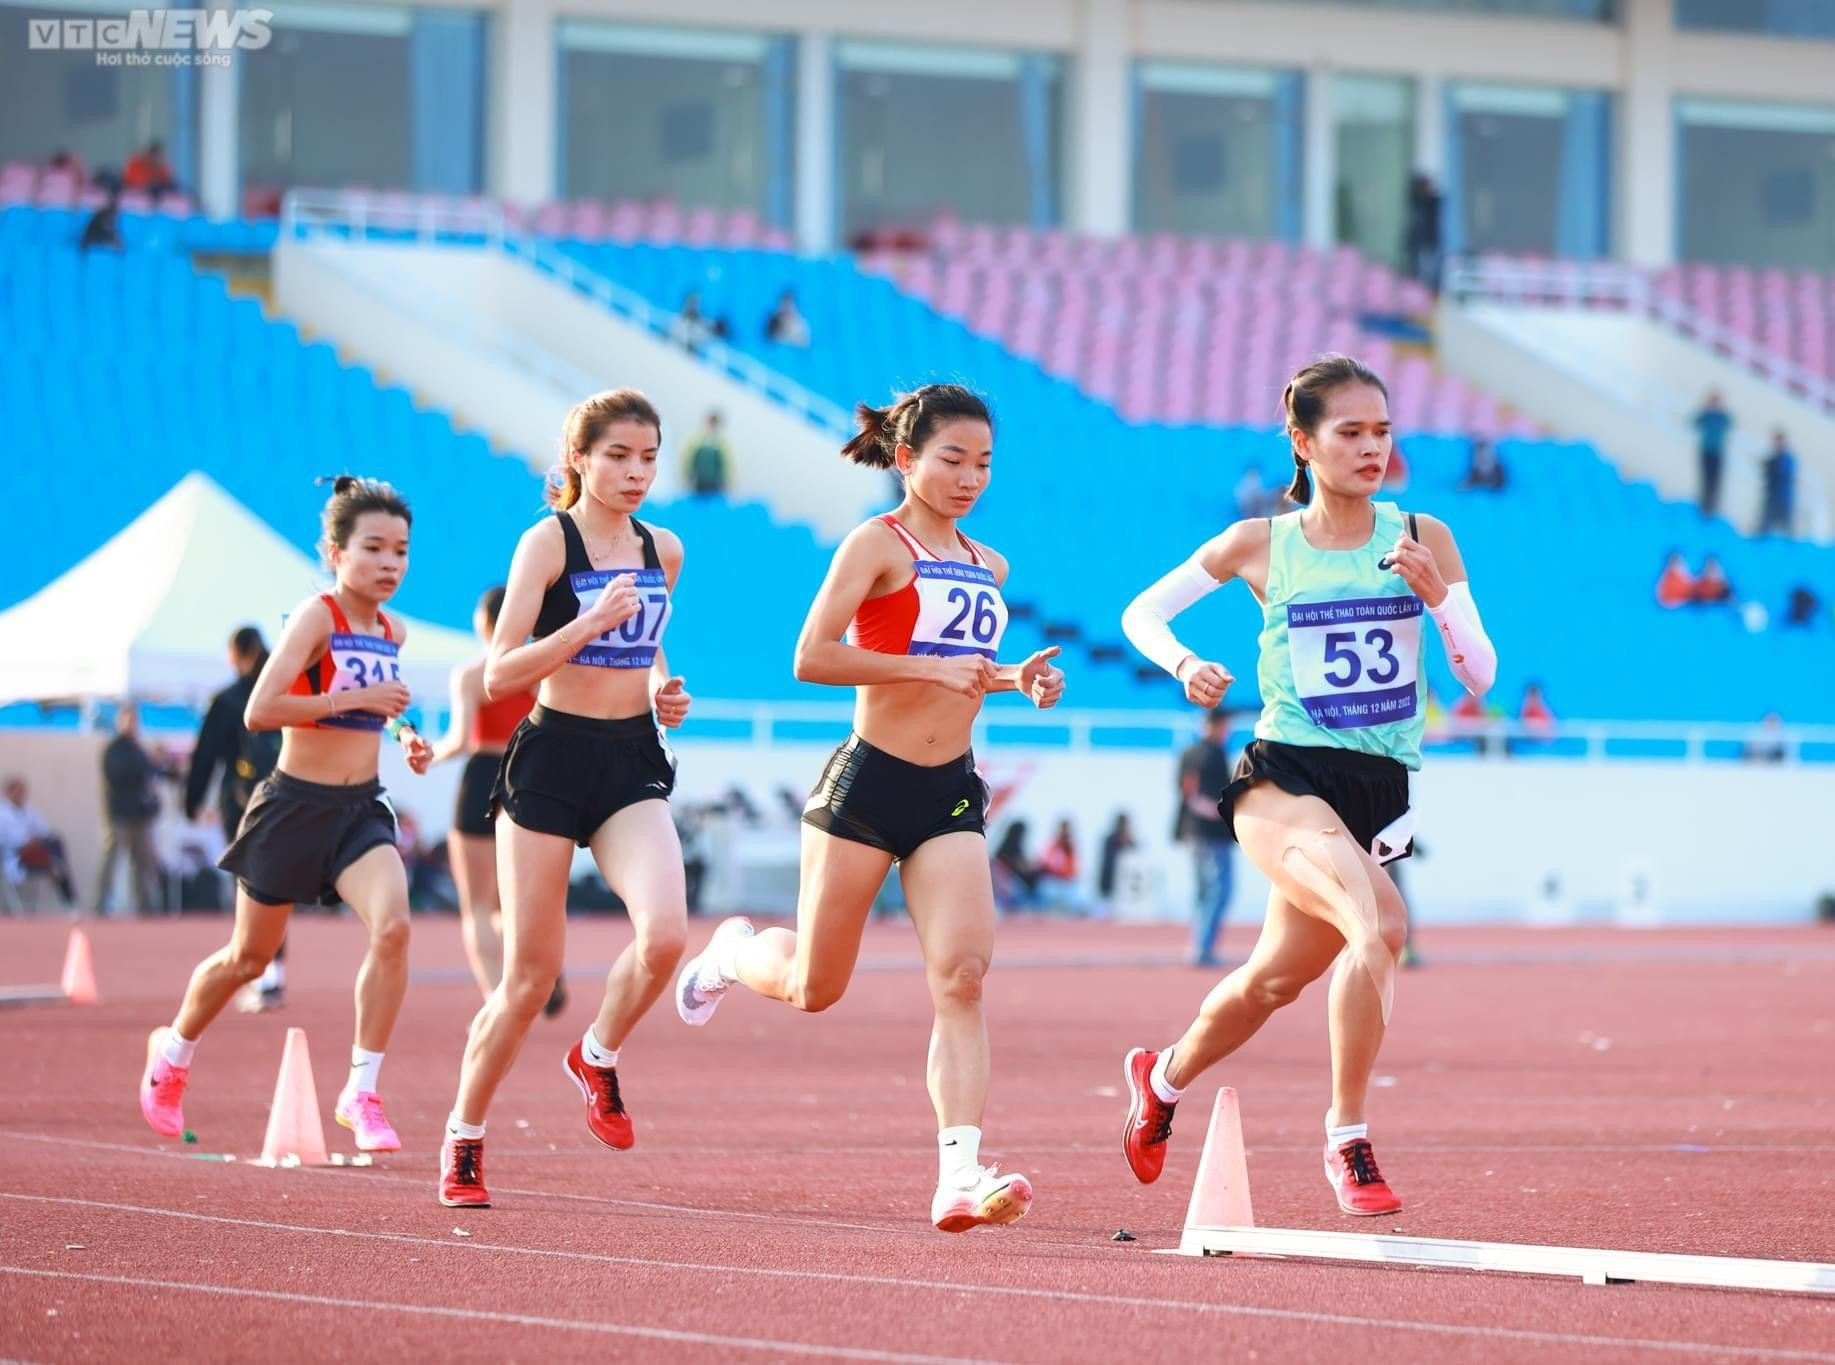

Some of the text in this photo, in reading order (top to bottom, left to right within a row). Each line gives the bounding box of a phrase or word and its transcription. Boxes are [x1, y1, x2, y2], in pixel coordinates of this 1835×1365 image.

[601, 594, 667, 643] 07
[939, 587, 997, 644] 26
[1291, 611, 1304, 623] ĐẠI
[1335, 607, 1355, 618] THAO
[1324, 628, 1400, 688] 53
[1370, 703, 1380, 714] 12
